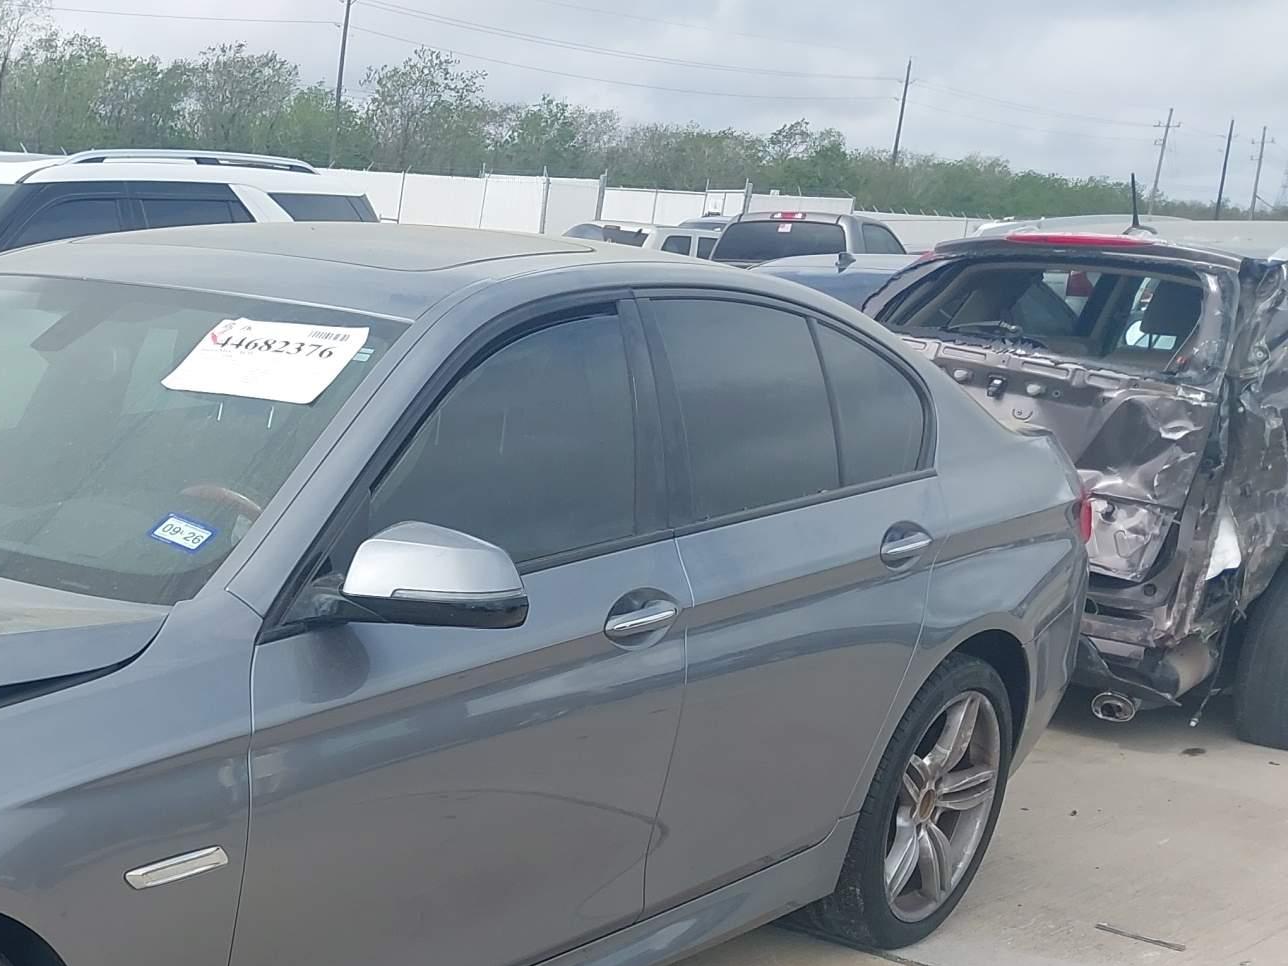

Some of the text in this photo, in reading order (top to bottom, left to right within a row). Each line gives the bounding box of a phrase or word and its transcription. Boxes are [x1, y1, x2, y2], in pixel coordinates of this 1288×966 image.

[215, 335, 336, 360] 44682376
[161, 523, 204, 545] 09 26
